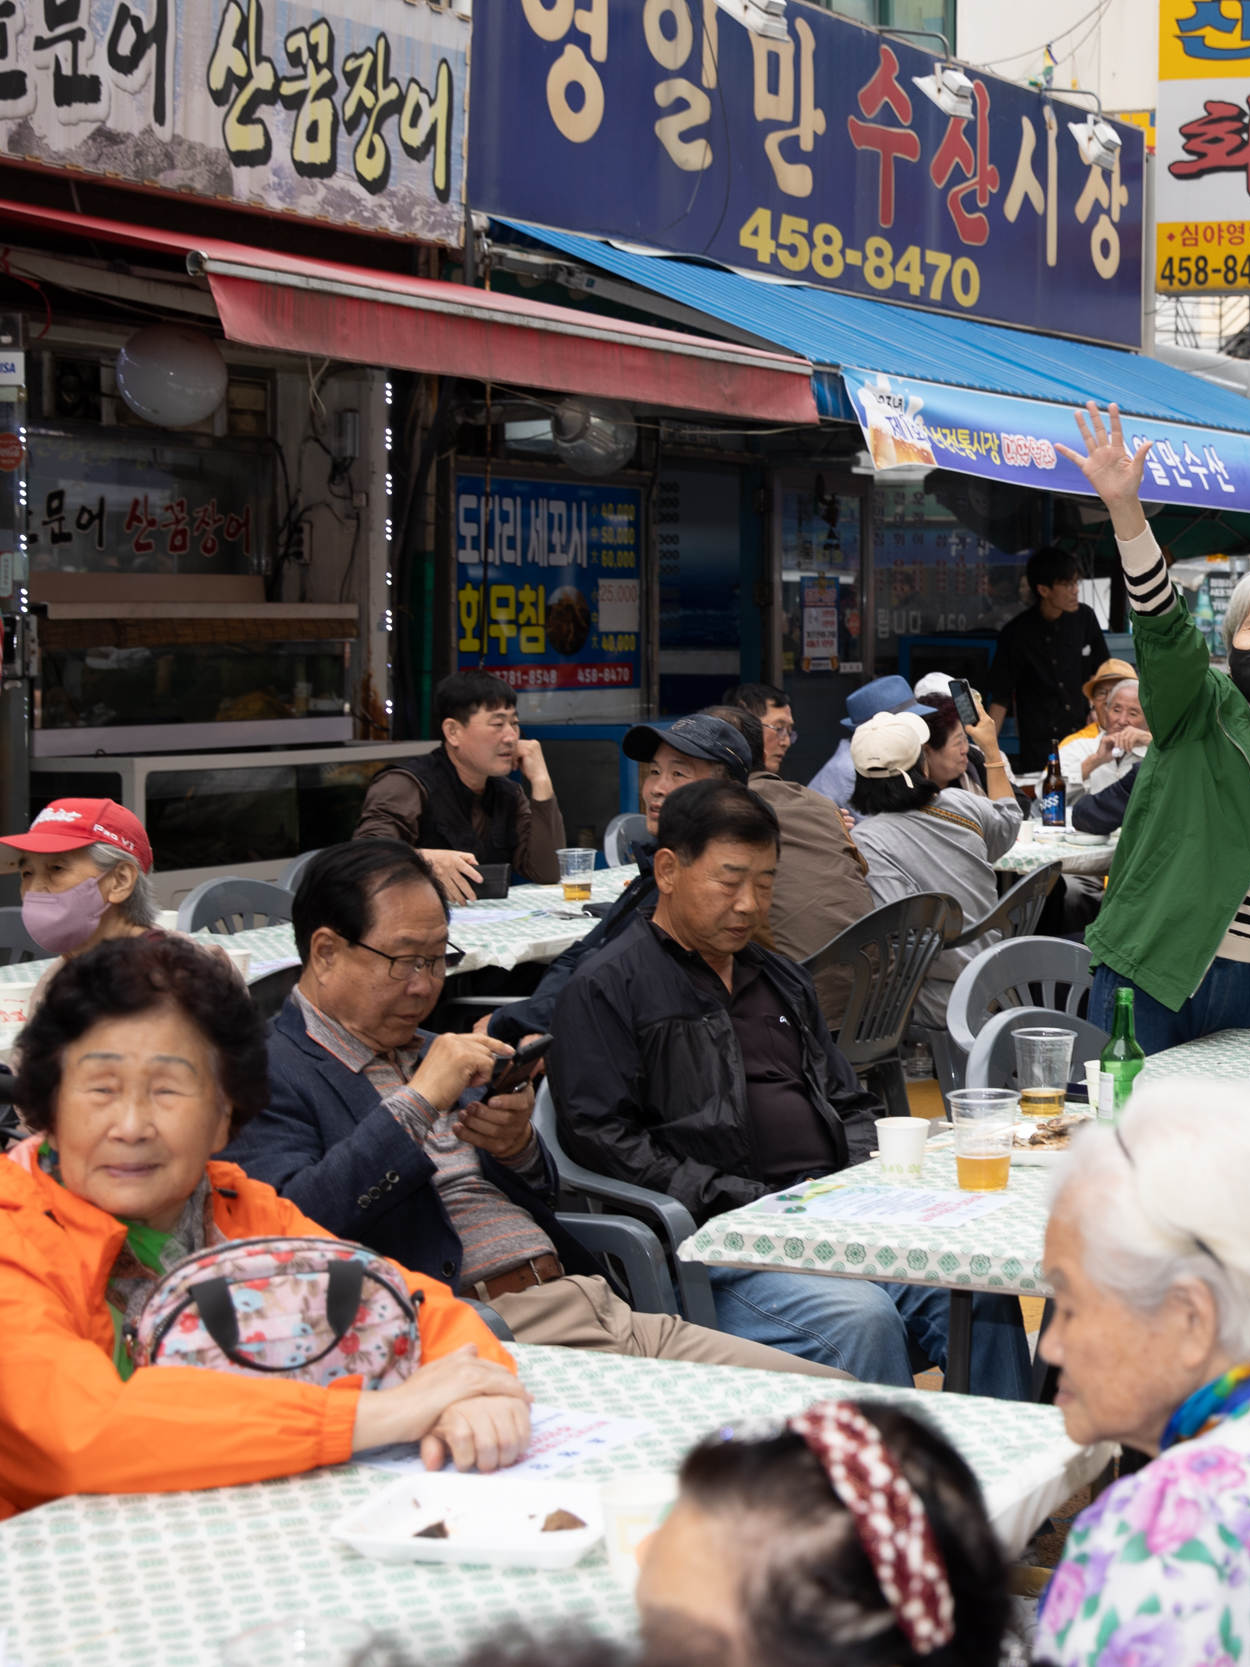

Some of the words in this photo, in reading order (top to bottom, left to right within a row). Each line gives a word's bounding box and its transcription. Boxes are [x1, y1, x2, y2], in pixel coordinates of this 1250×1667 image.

[0, 0, 168, 128] 문어
[739, 206, 980, 308] 458-8470
[0, 362, 16, 374] ISA
[1107, 432, 1237, 494] 일만수산
[124, 494, 250, 556] 산꼼장어
[458, 493, 522, 567] 도다리
[527, 496, 588, 569] 세꼬시
[458, 581, 546, 655] 회무침
[577, 667, 630, 683] 458-8470
